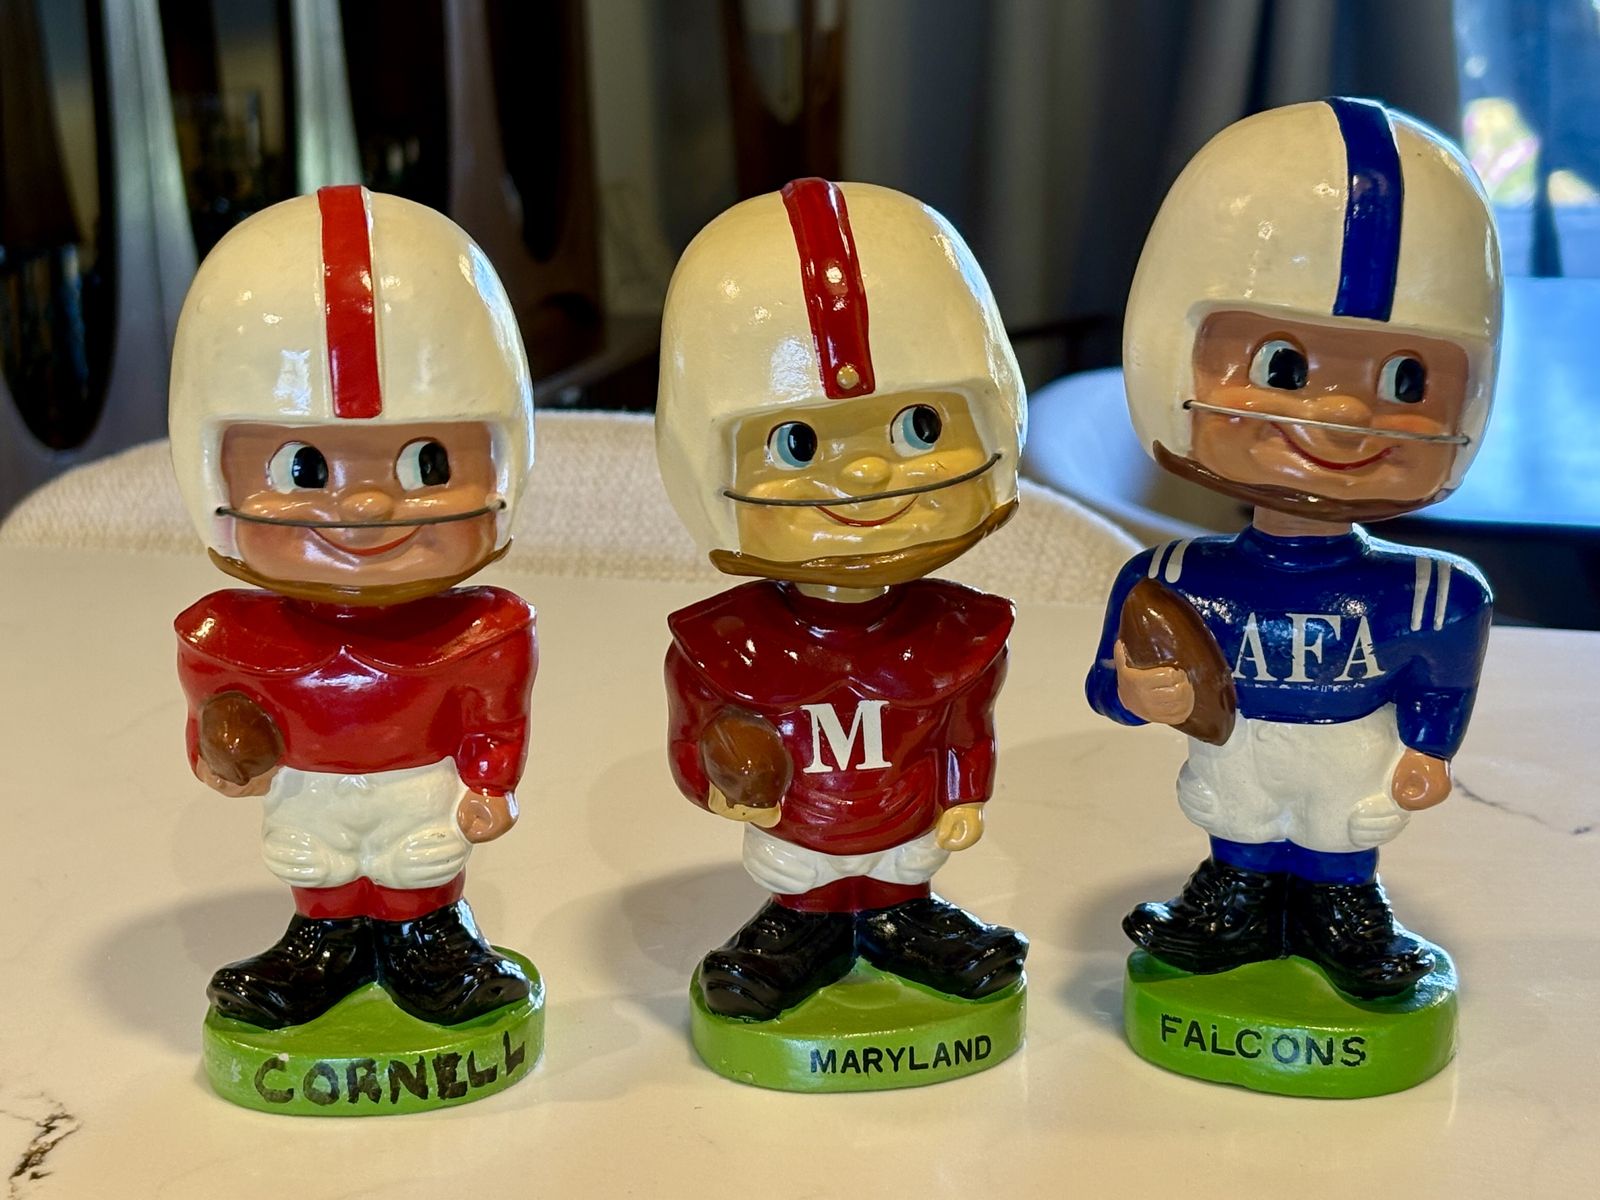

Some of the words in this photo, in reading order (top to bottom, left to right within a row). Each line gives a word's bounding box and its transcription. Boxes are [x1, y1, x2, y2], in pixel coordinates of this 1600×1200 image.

[1232, 612, 1386, 682] AFA
[800, 700, 892, 773] M
[254, 1030, 525, 1105] CORNELL
[810, 1035, 992, 1074] MARYLAND
[1161, 1013, 1366, 1066] FALCONS
